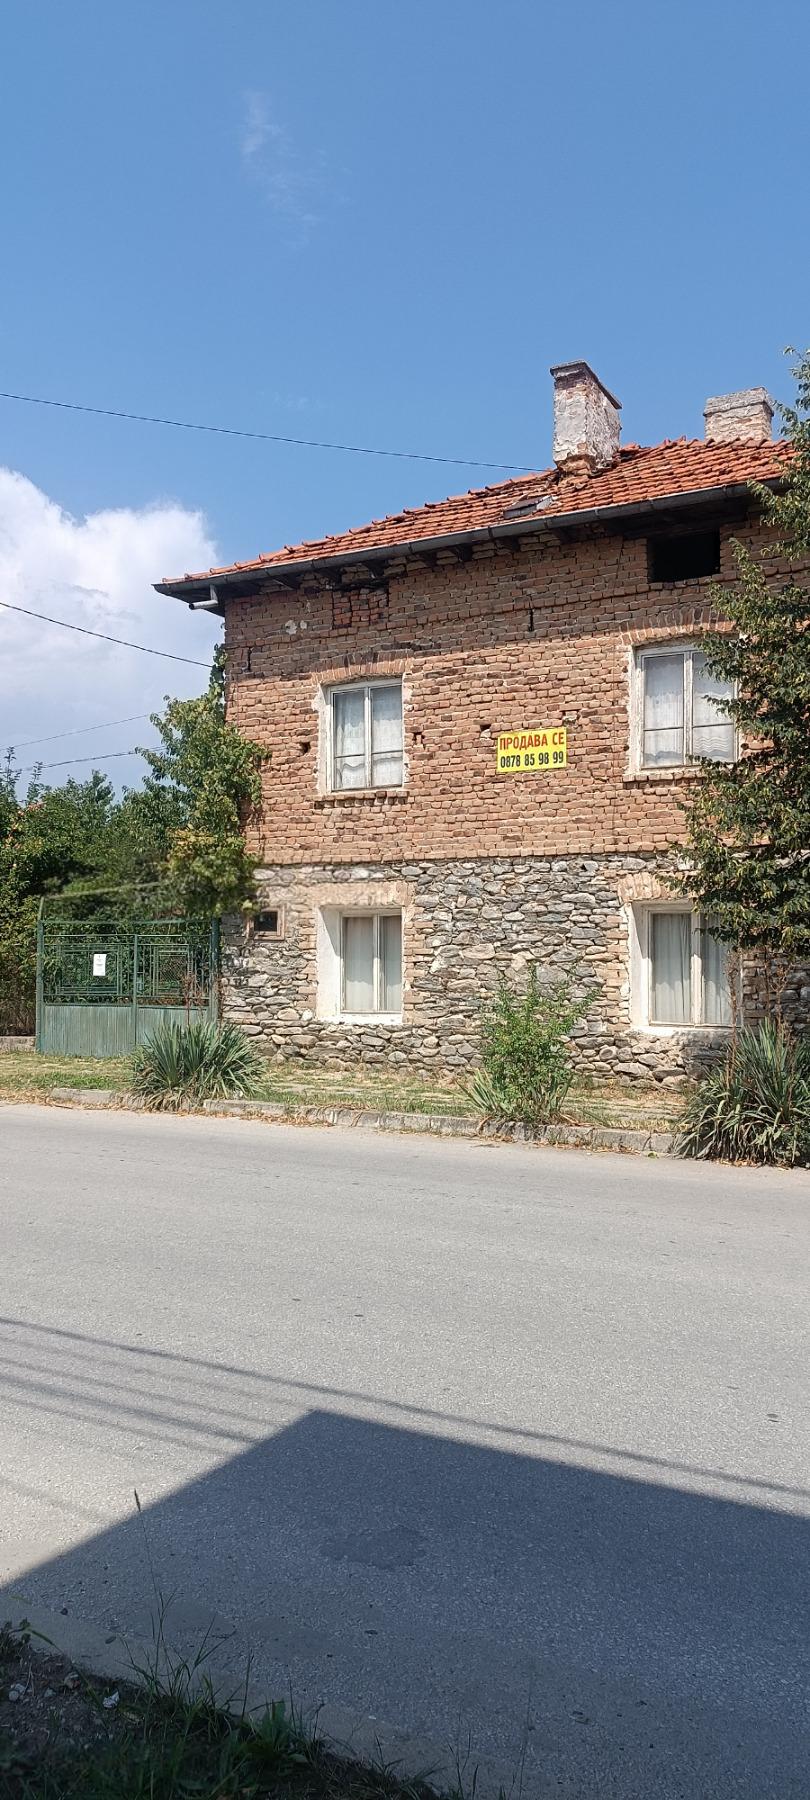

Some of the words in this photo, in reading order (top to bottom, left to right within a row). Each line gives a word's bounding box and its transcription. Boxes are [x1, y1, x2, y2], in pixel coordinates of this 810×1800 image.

[499, 733, 548, 750] ПРОДАВА
[552, 732, 565, 745] СЕ
[500, 754, 520, 768] 0878
[524, 753, 535, 766] 85
[538, 752, 549, 765] 98
[553, 751, 564, 764] 99
